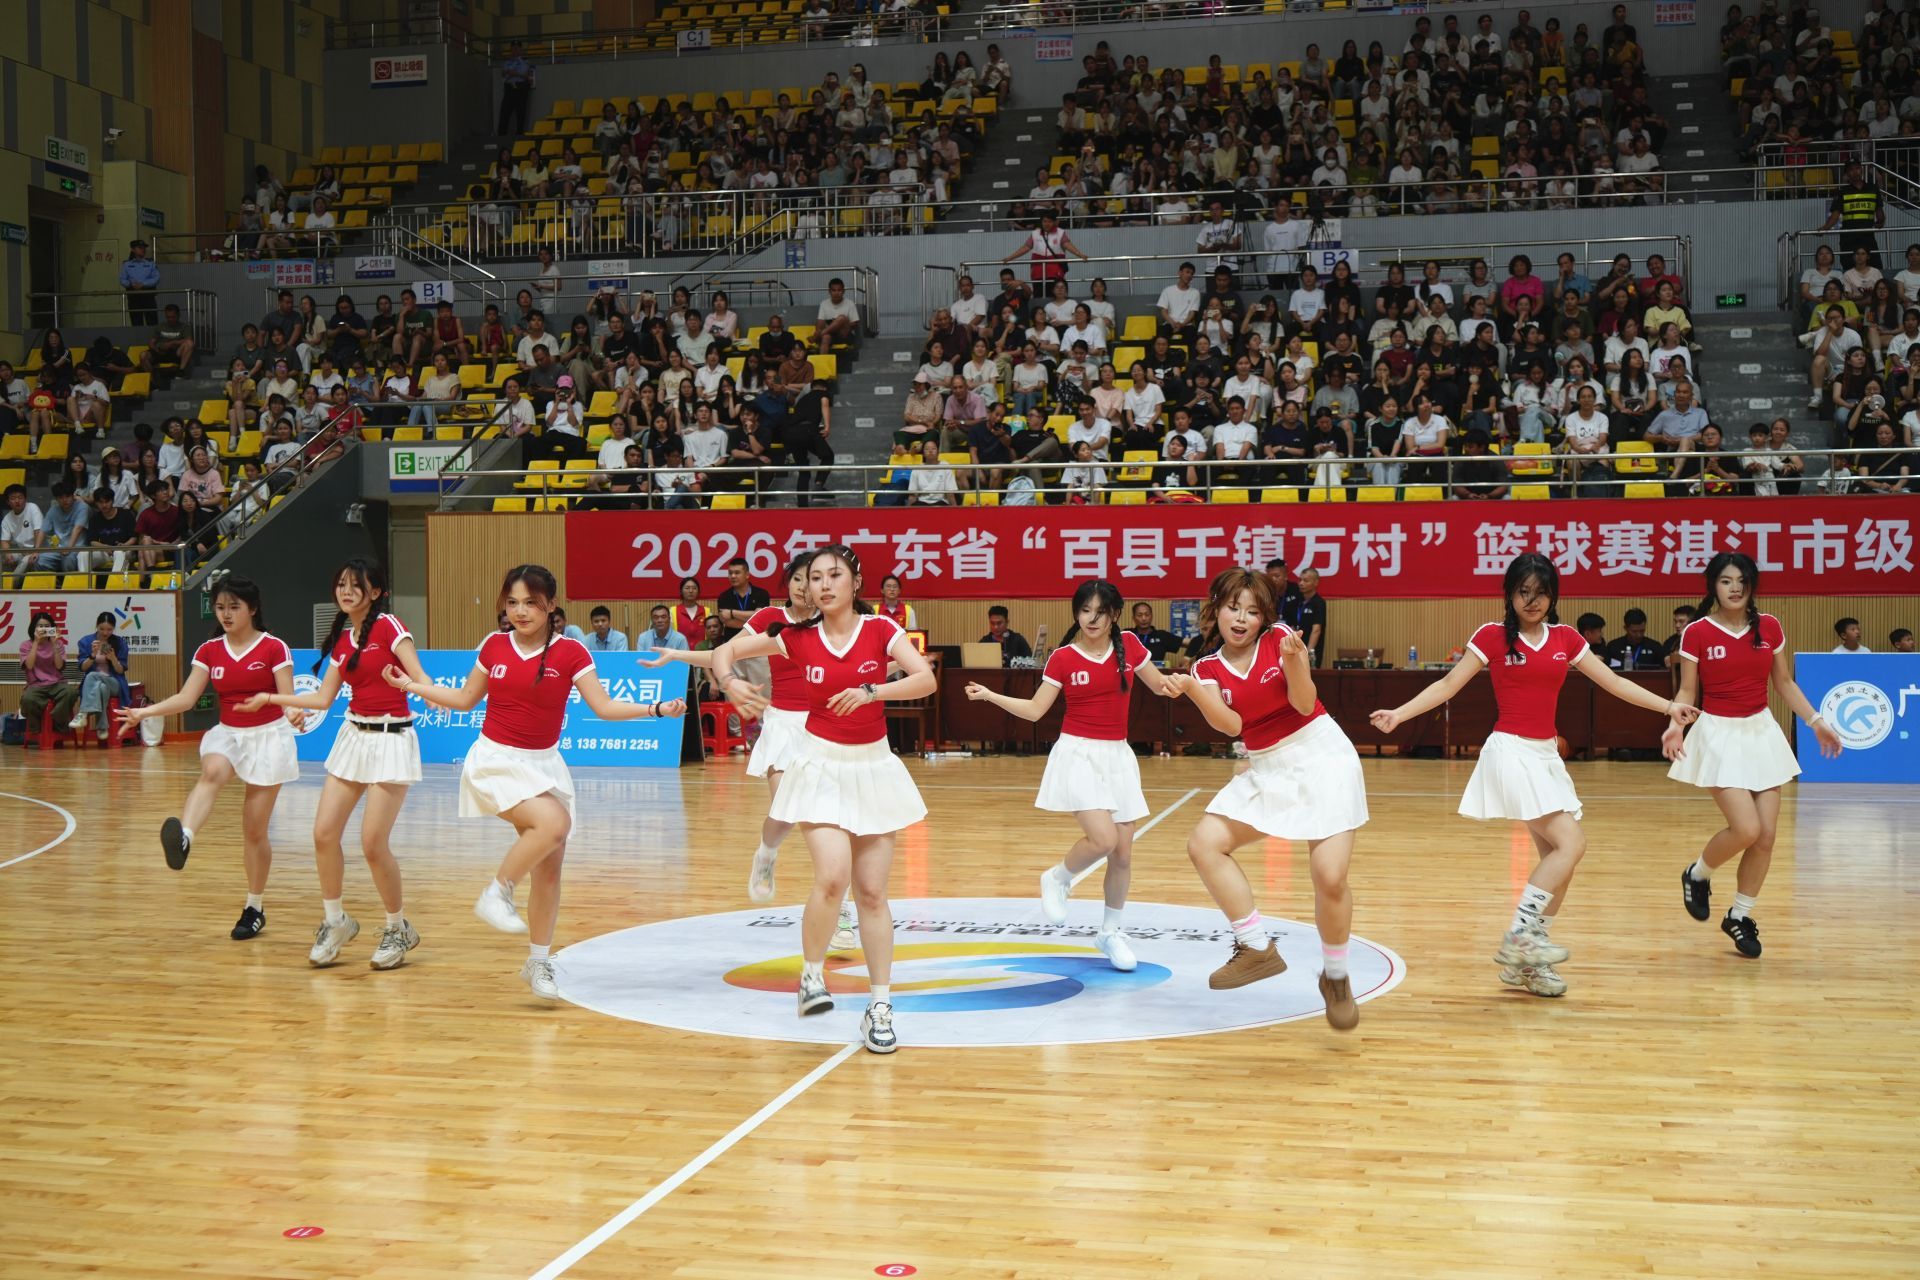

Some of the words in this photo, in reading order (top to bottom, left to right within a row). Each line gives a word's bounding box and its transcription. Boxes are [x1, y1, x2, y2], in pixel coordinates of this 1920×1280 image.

[687, 31, 704, 42] C1
[60, 146, 74, 160] EXIT
[74, 149, 86, 165] 出口
[1323, 251, 1349, 266] B2
[423, 283, 443, 297] B1
[418, 456, 442, 471] EXIT
[1706, 645, 1727, 661] 10
[210, 666, 225, 680] 10
[490, 663, 508, 680] 10
[806, 664, 825, 684] 10
[1070, 670, 1090, 686] 10
[577, 738, 597, 750] 138
[600, 738, 626, 750] 7681
[629, 738, 659, 751] 2254
